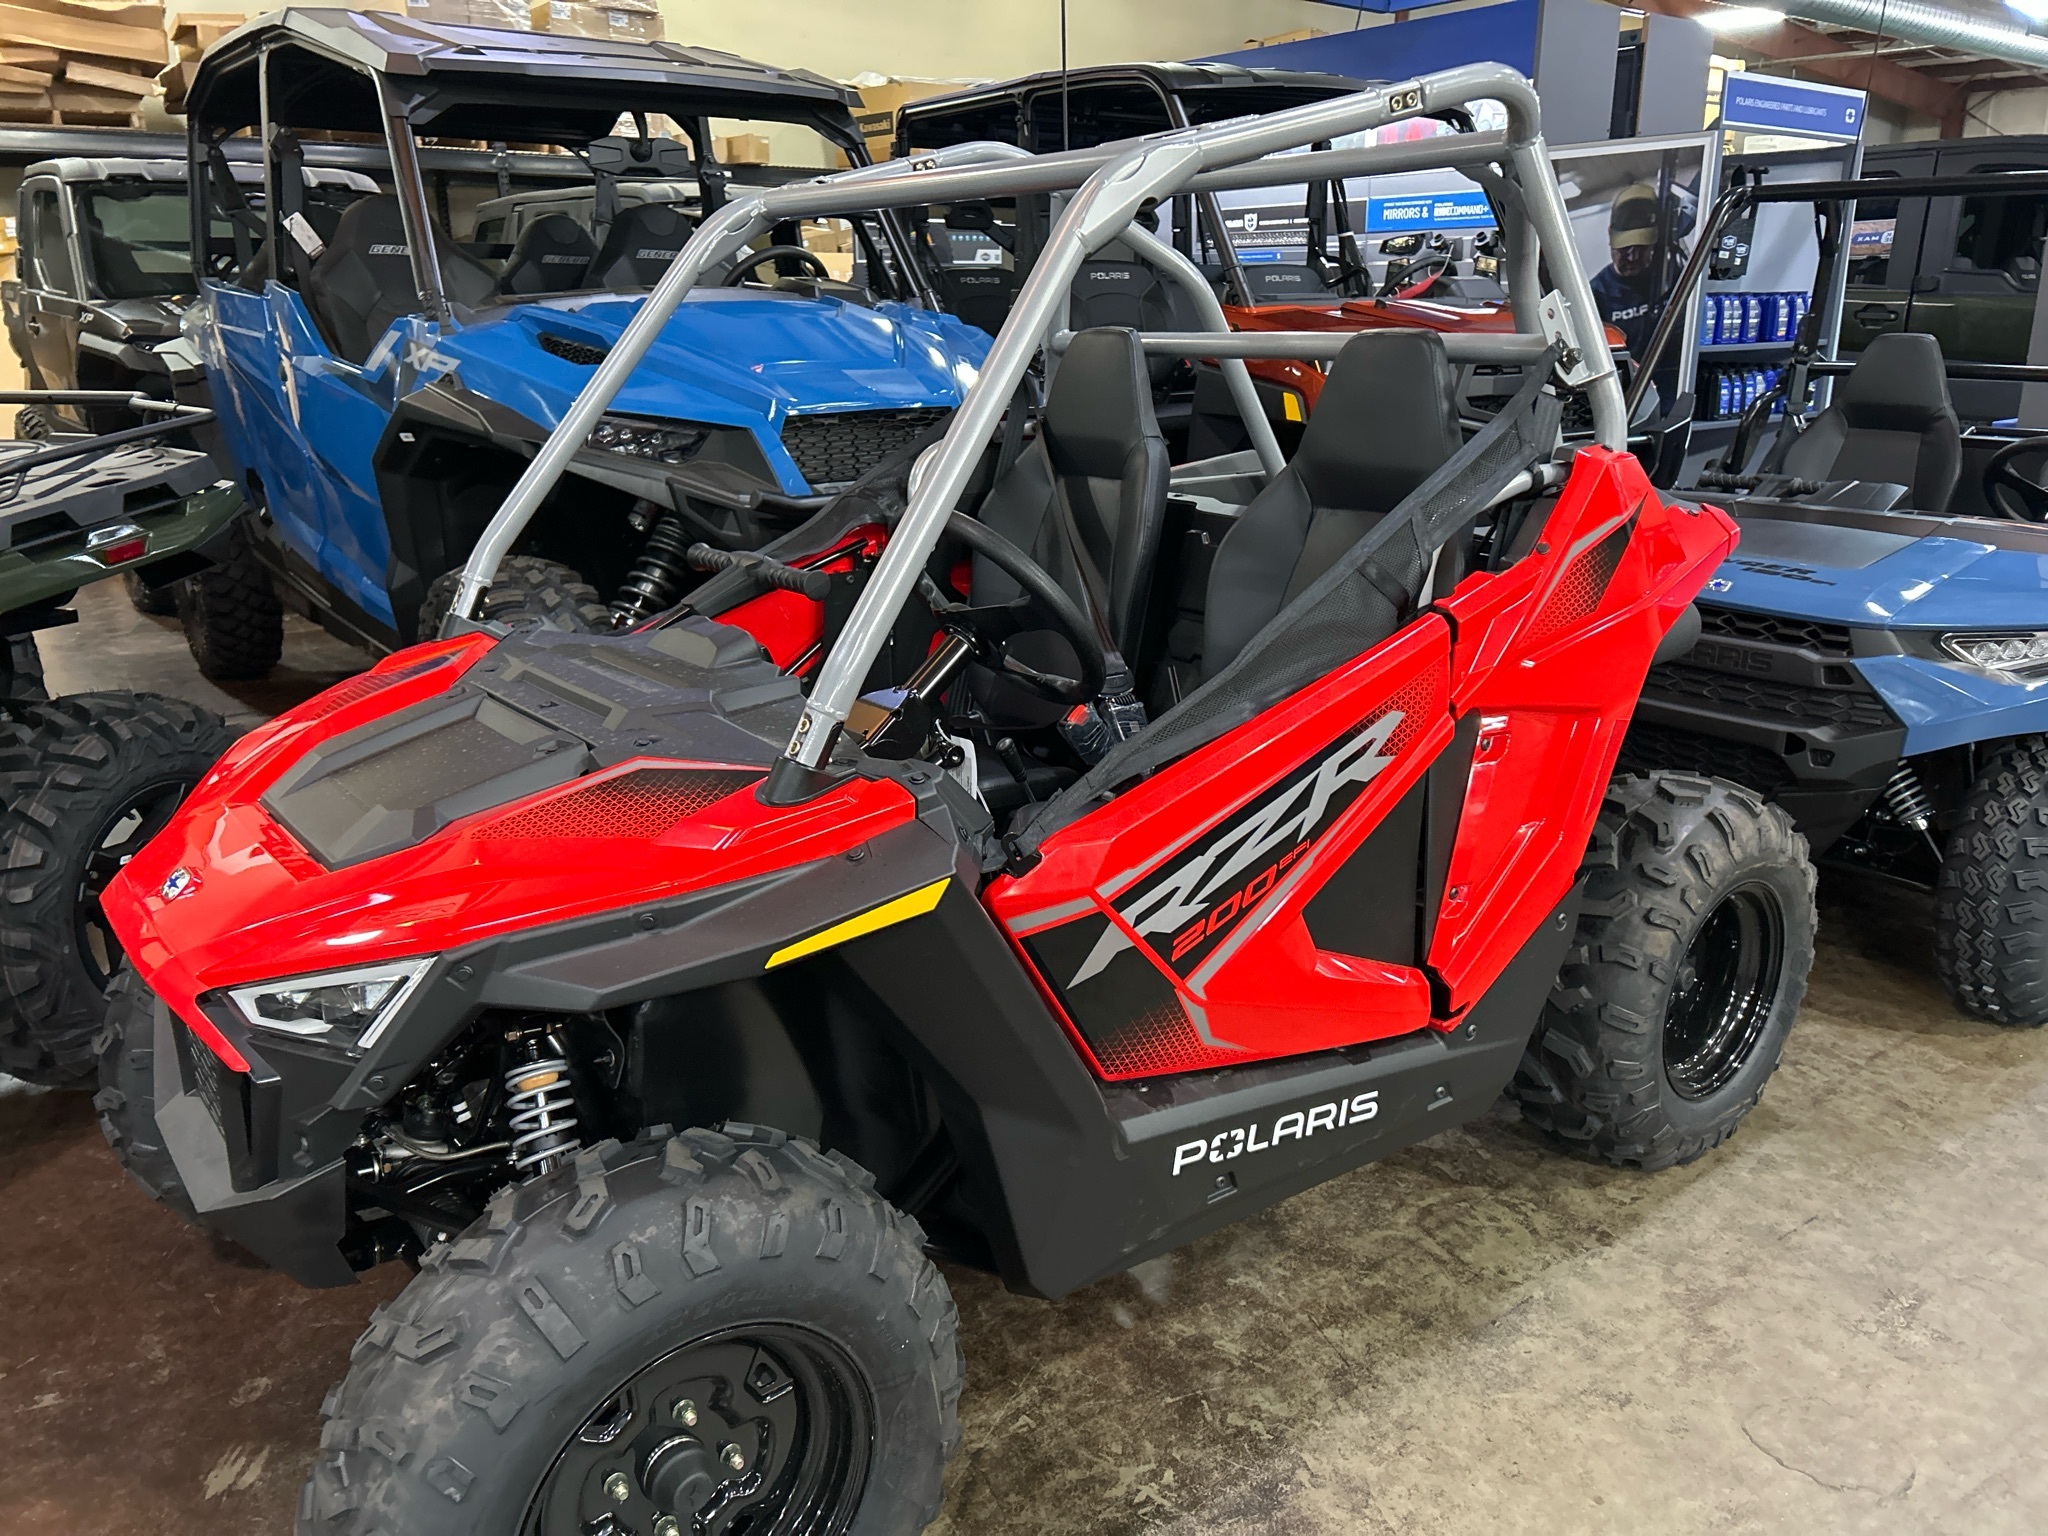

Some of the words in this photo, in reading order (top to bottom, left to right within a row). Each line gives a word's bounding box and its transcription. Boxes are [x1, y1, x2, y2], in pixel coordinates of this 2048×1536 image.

[1735, 96, 1754, 107] POLARIS
[1383, 207, 1420, 220] MIRRORS
[1421, 206, 1429, 218] &
[368, 243, 412, 256] GENE
[635, 248, 683, 261] GENER
[960, 276, 1000, 285] POLARIS
[1089, 271, 1130, 281] POLARIS
[1264, 274, 1302, 283] POLARIS
[78, 310, 95, 324] XP
[403, 341, 462, 373] XP
[1690, 640, 1774, 674] ARIS
[1066, 710, 1406, 990] RZR
[1171, 863, 1278, 963] 200
[1278, 838, 1311, 870] EFI
[1171, 1090, 1380, 1177] POLARIS
